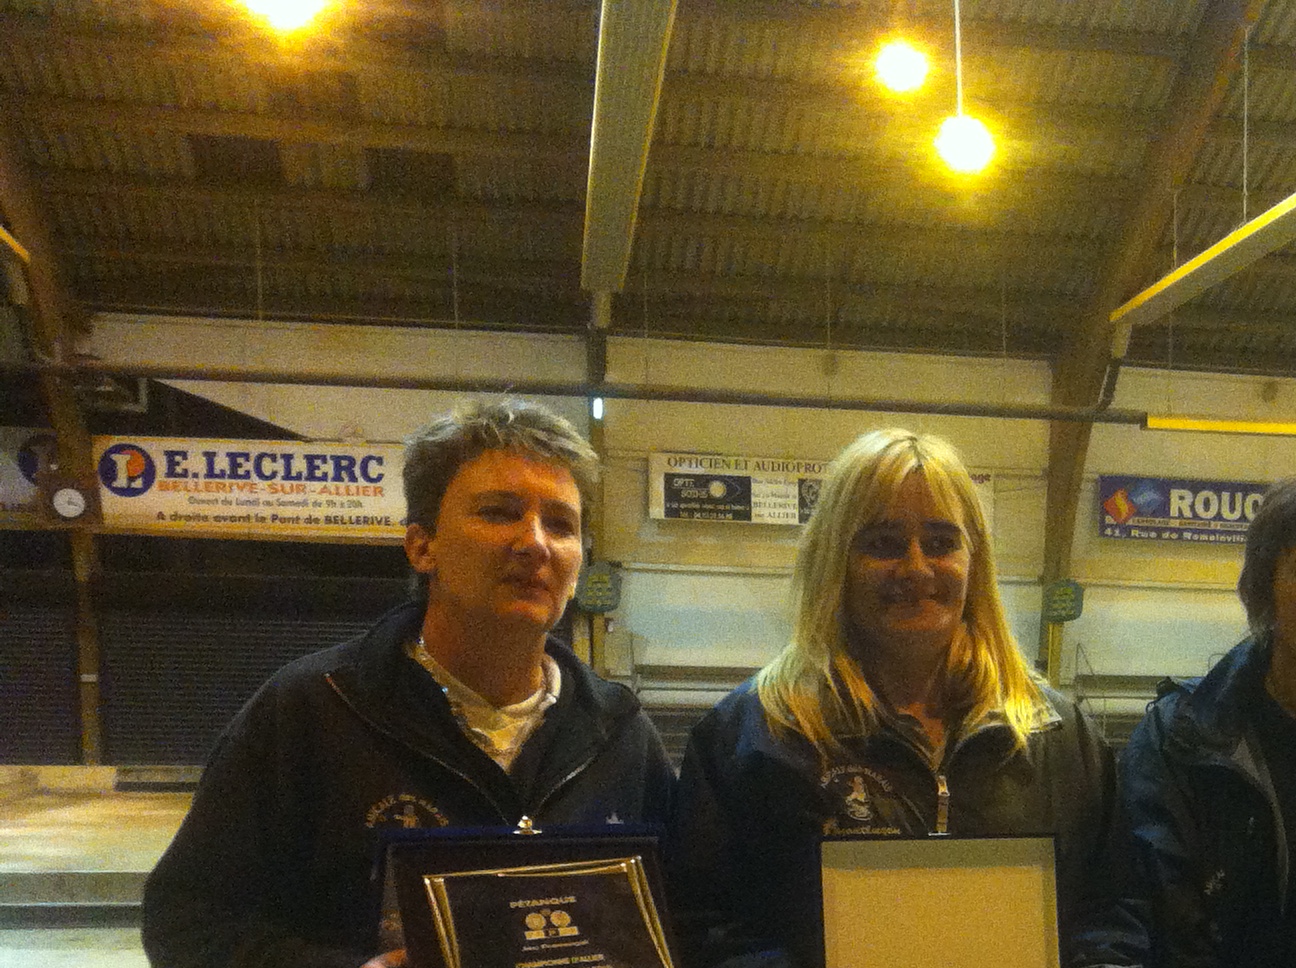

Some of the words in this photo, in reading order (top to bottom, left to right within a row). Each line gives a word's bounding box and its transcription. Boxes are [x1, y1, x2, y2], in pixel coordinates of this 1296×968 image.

[163, 450, 385, 484] E.LECLERC
[667, 457, 731, 470] OPTICIEN
[734, 459, 749, 470] ET
[169, 511, 209, 522] droite
[213, 513, 250, 524] avant
[254, 513, 267, 524] le
[270, 514, 300, 525] Pont
[304, 514, 321, 525] de
[1130, 529, 1158, 538] Rue
